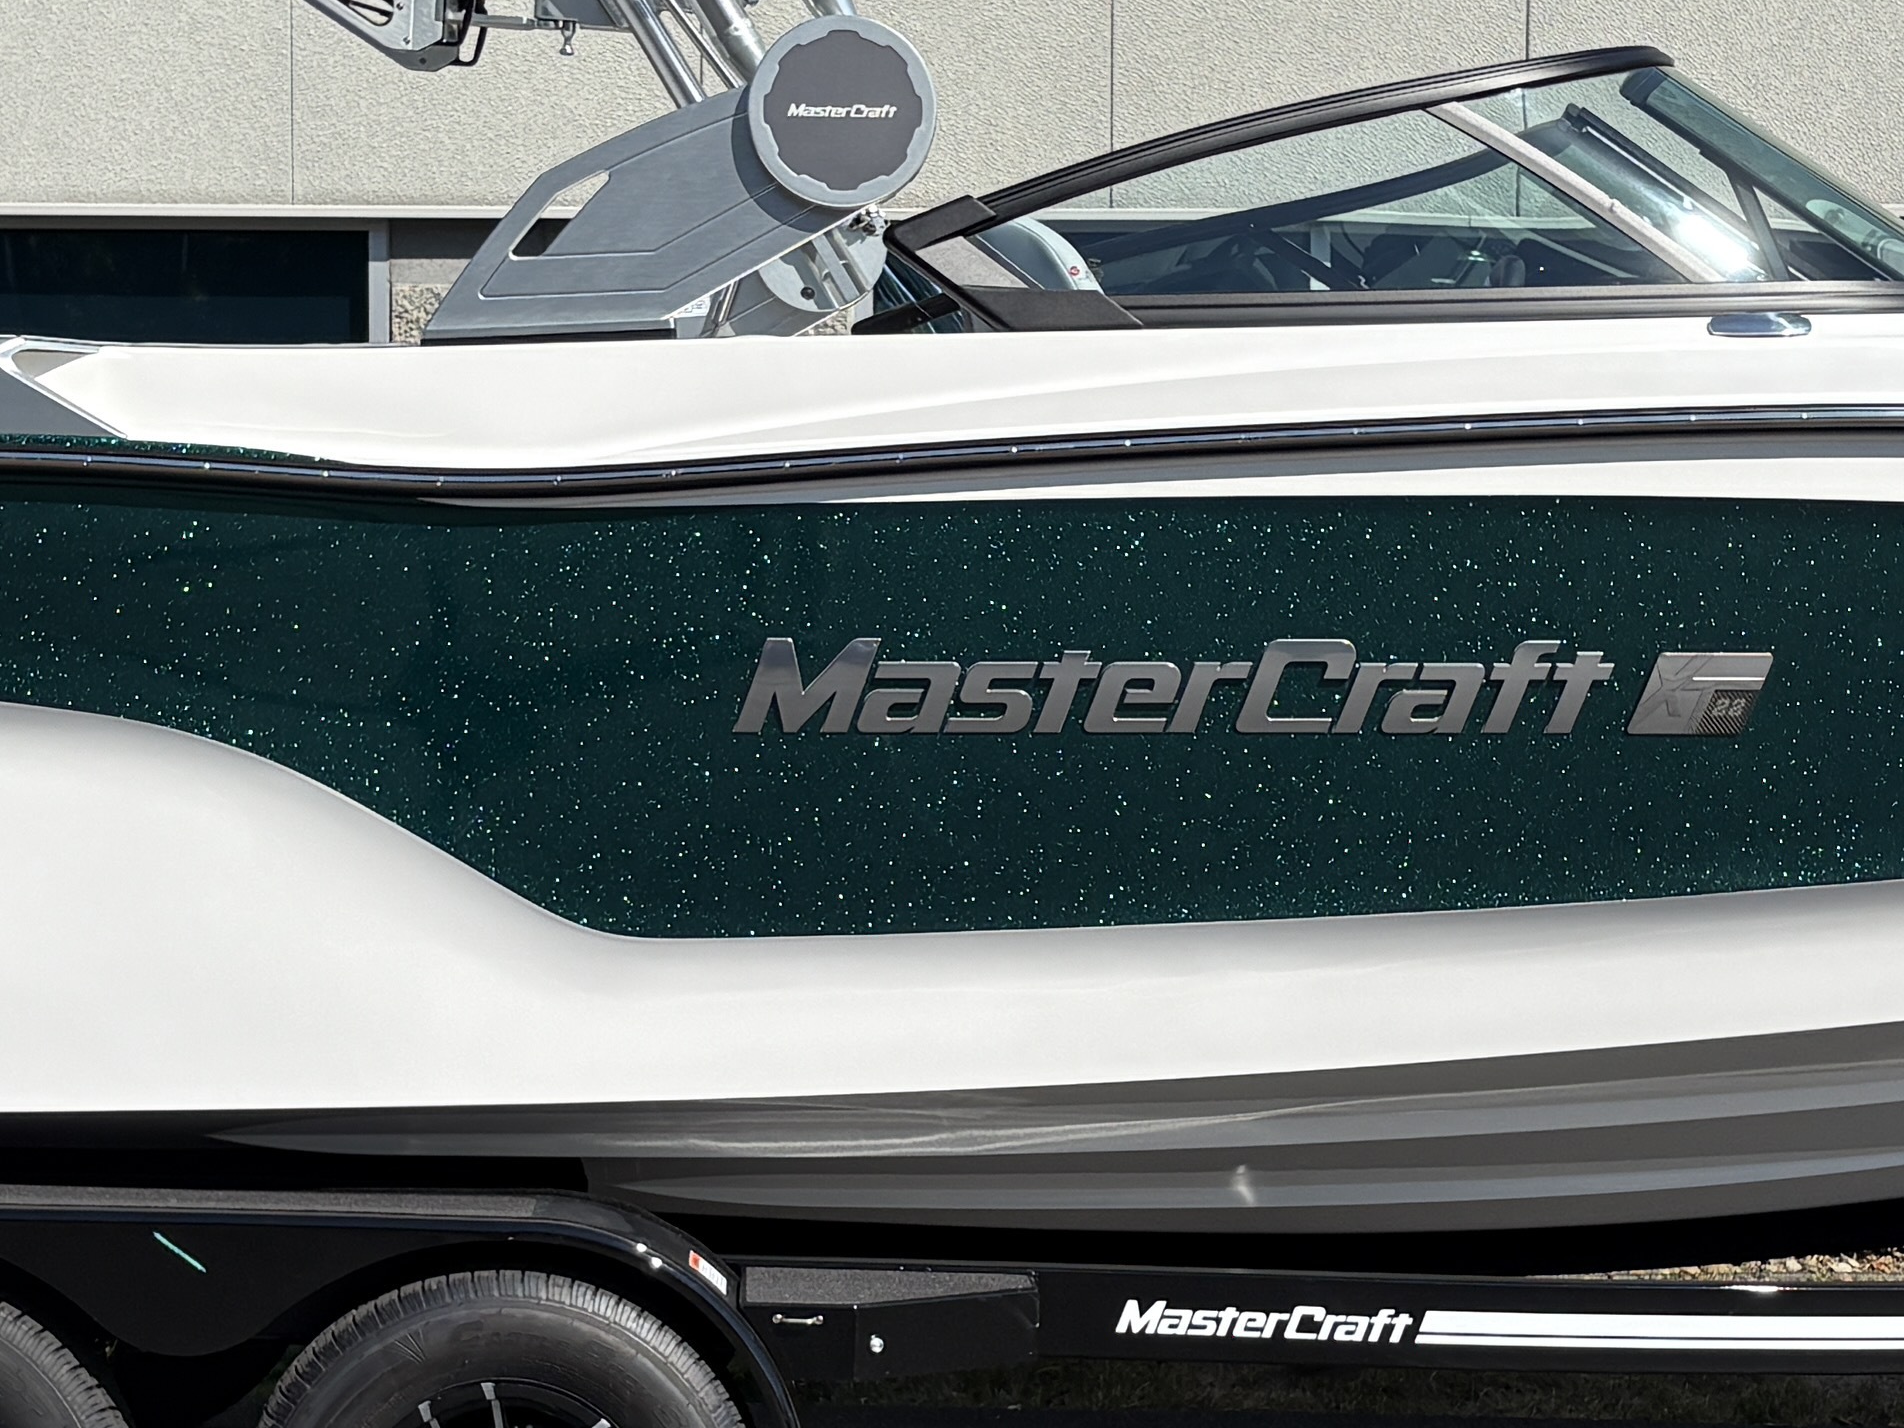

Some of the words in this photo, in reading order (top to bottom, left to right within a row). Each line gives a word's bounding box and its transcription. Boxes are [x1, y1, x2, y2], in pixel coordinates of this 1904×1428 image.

[787, 103, 897, 118] MasterCraft
[731, 636, 1615, 735] MasterCraft
[1115, 1299, 1413, 1343] MasterCraft
